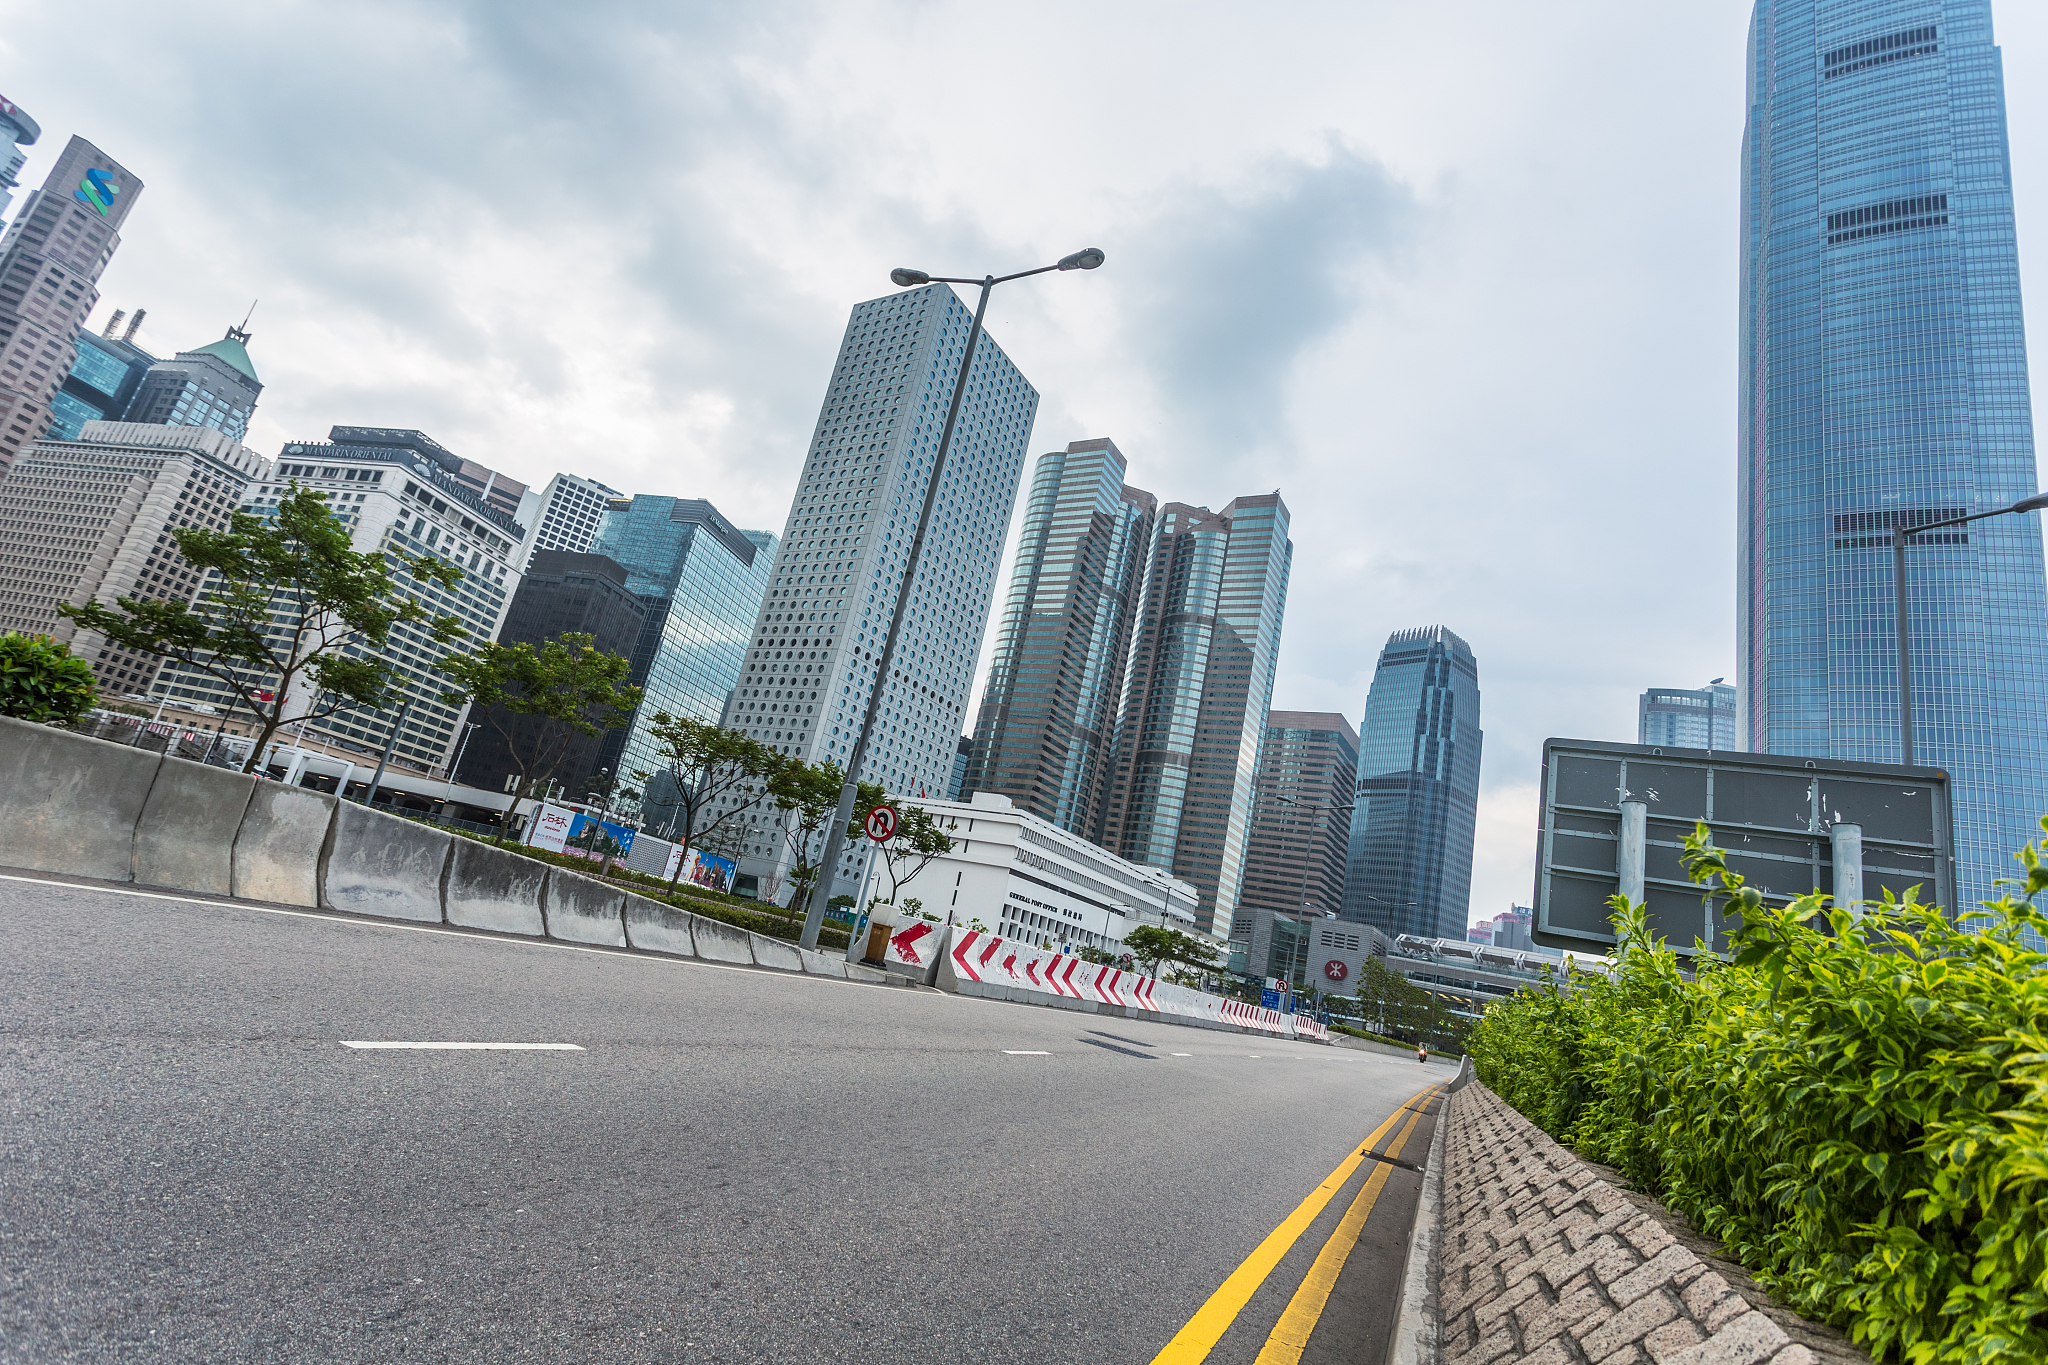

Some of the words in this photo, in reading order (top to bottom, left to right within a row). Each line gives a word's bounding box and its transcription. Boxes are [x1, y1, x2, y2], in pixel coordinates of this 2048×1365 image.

[305, 446, 349, 457] MANDARIN
[350, 449, 393, 461] ORIENTAL
[432, 473, 480, 510] MANDARIN
[480, 506, 518, 534] ORIENTAL
[1009, 891, 1031, 904] GENERAL
